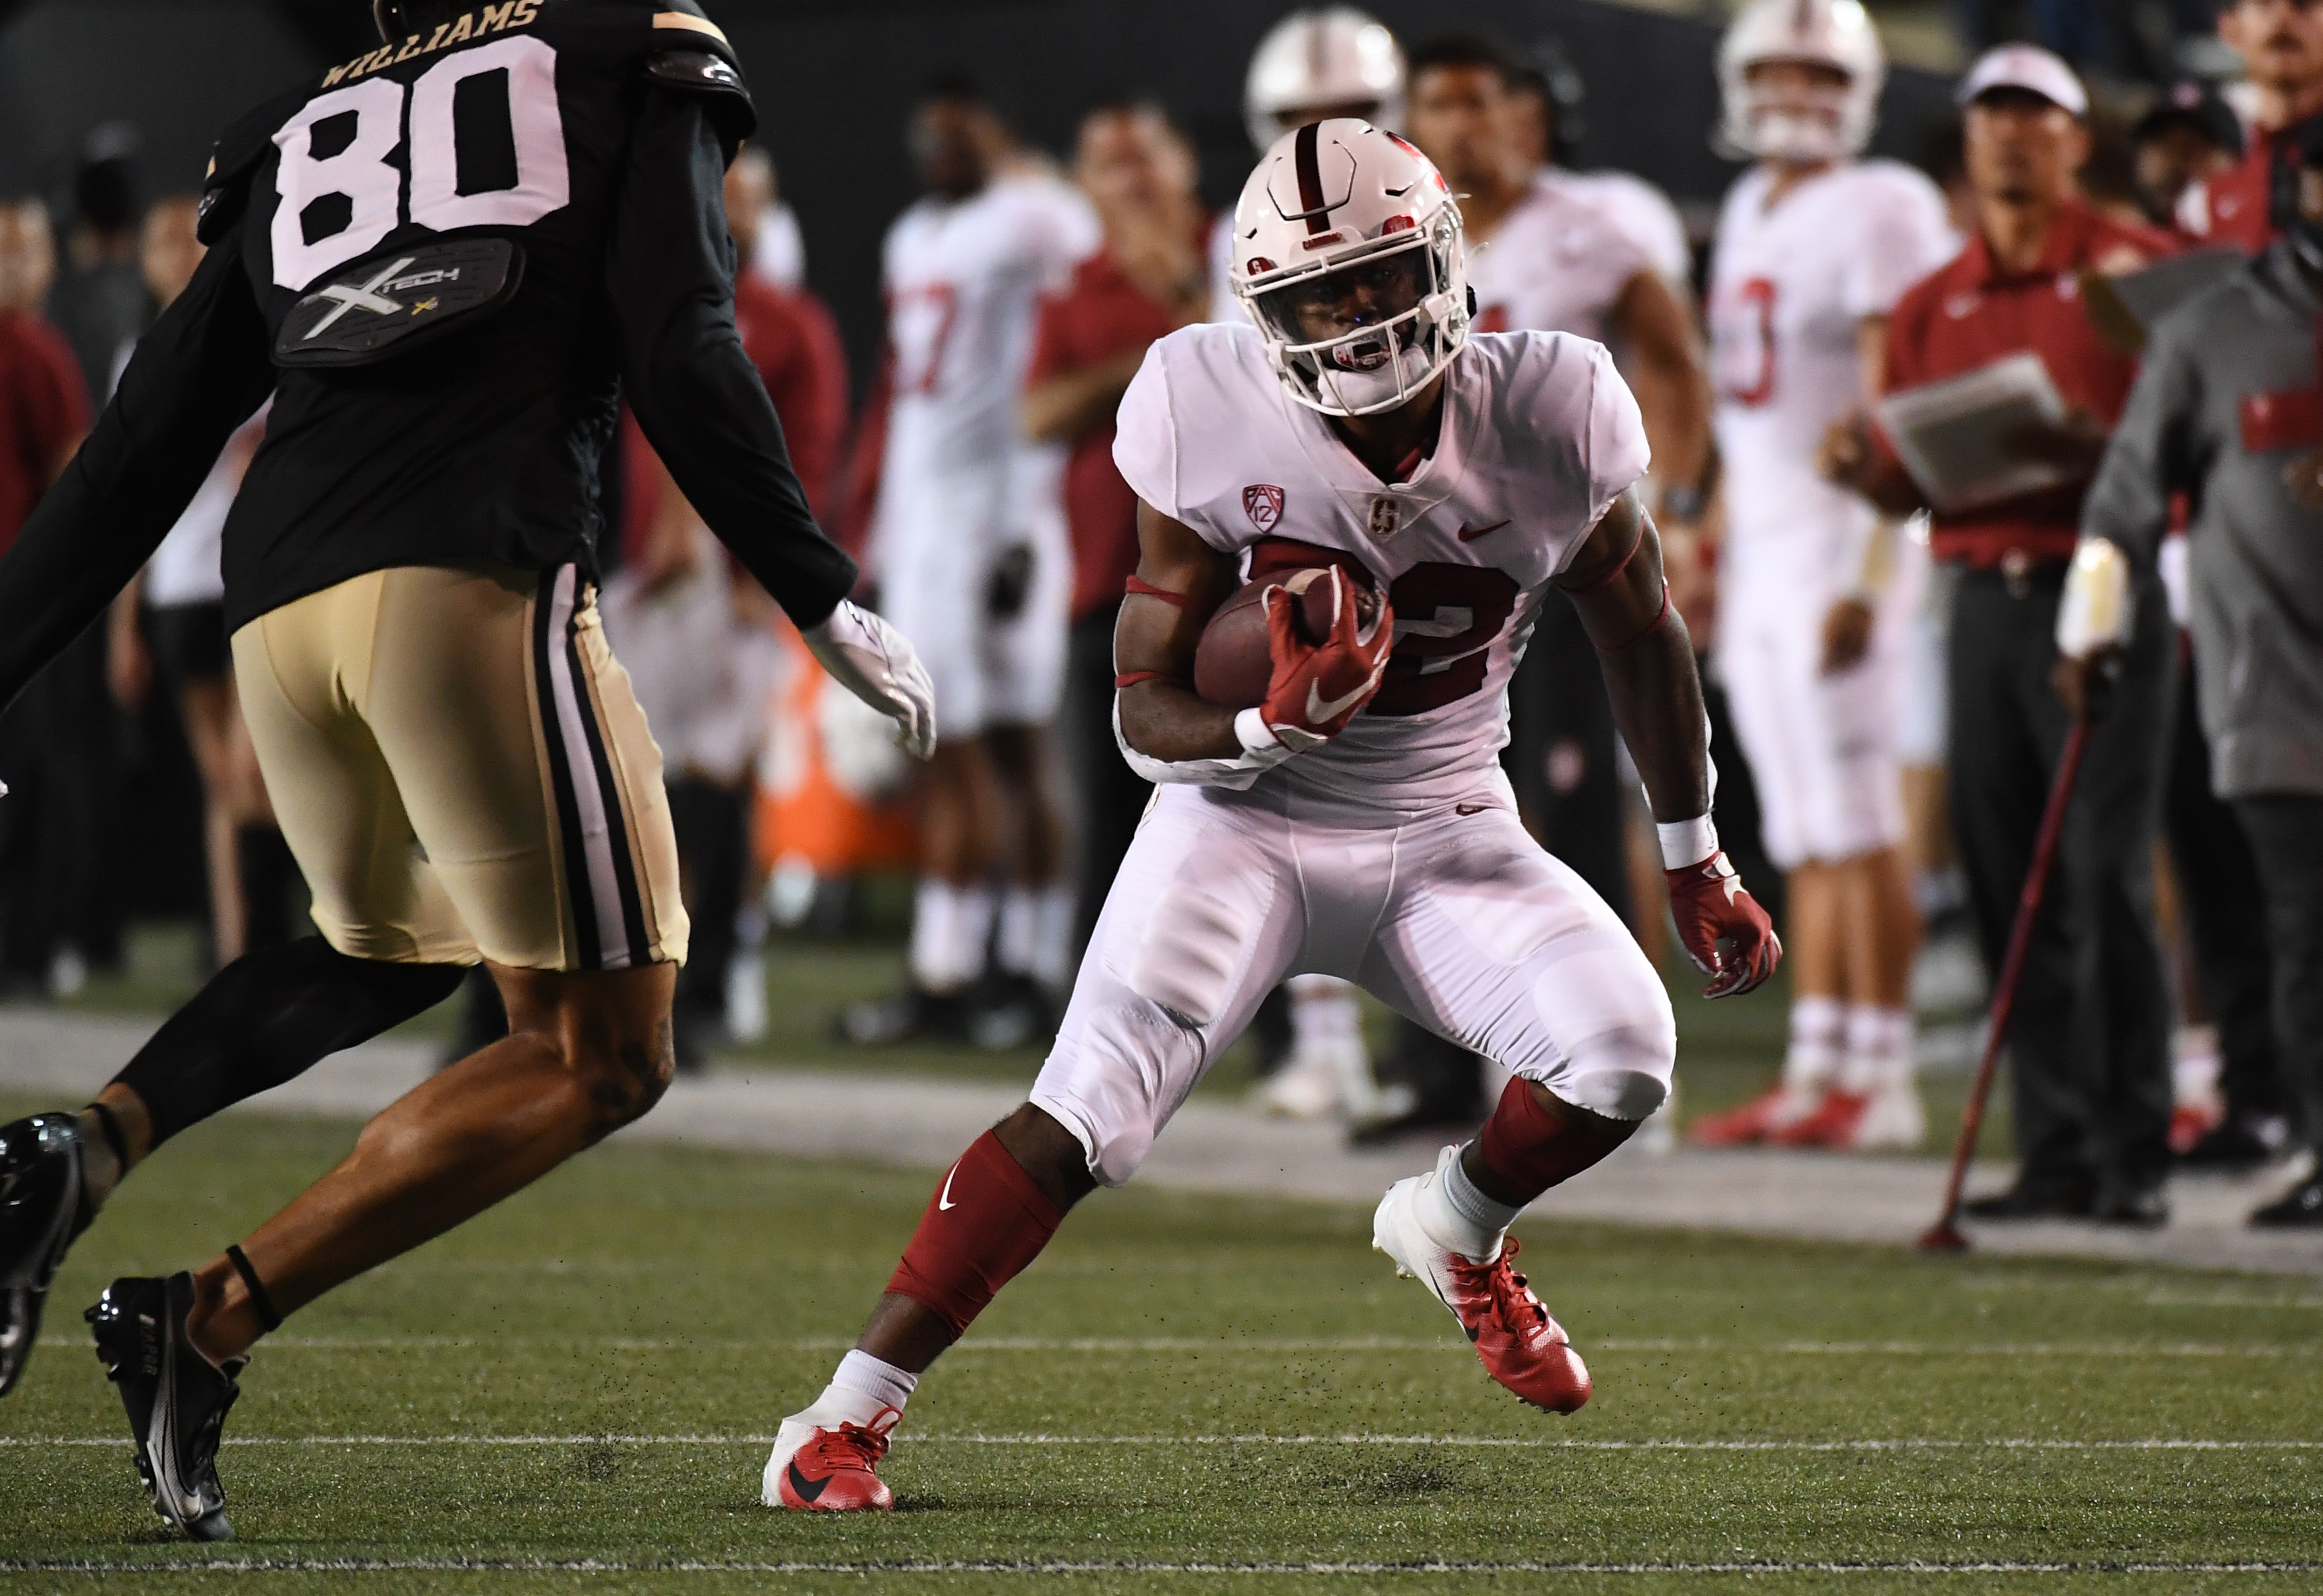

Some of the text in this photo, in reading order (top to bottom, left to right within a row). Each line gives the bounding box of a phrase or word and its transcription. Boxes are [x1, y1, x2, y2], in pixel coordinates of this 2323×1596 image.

[321, 0, 545, 88] WILLIAMS
[271, 35, 570, 292] 80
[1254, 505, 1274, 522] 12
